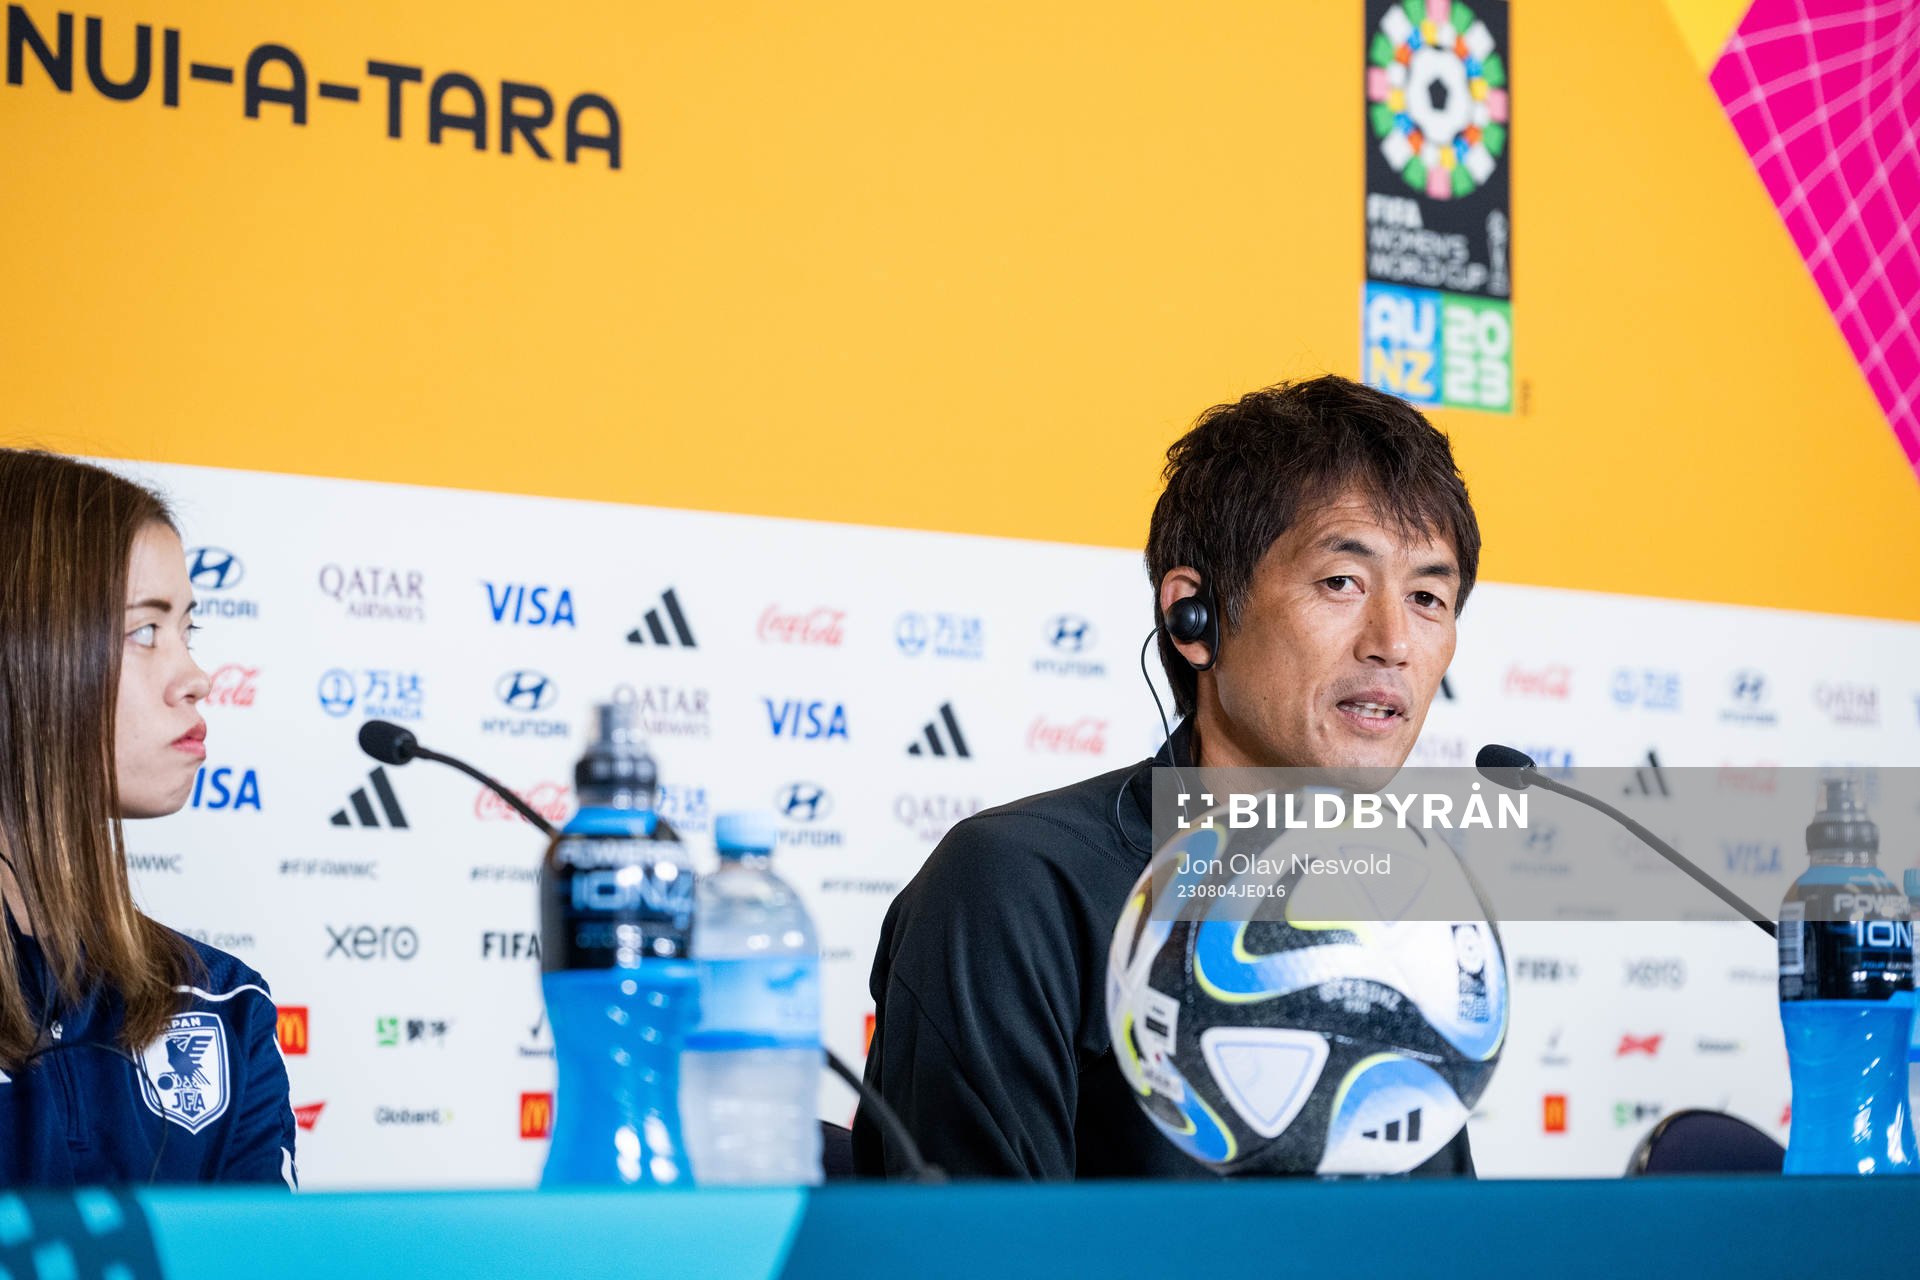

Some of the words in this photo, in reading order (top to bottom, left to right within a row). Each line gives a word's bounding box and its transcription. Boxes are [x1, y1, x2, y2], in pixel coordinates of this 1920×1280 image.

[6, 4, 622, 170] NUI-A-TARA
[1368, 294, 1436, 347] AU
[1445, 304, 1510, 357] 20
[1369, 346, 1434, 396] NZ
[1445, 355, 1510, 408] 23
[319, 563, 425, 600] QATAR
[481, 580, 576, 628] VISA
[763, 698, 848, 741] VISA
[190, 767, 263, 811] ISA
[325, 925, 418, 961] xero
[481, 931, 541, 960] FIFA
[162, 1016, 201, 1031] APAN
[171, 1091, 206, 1111] JFA
